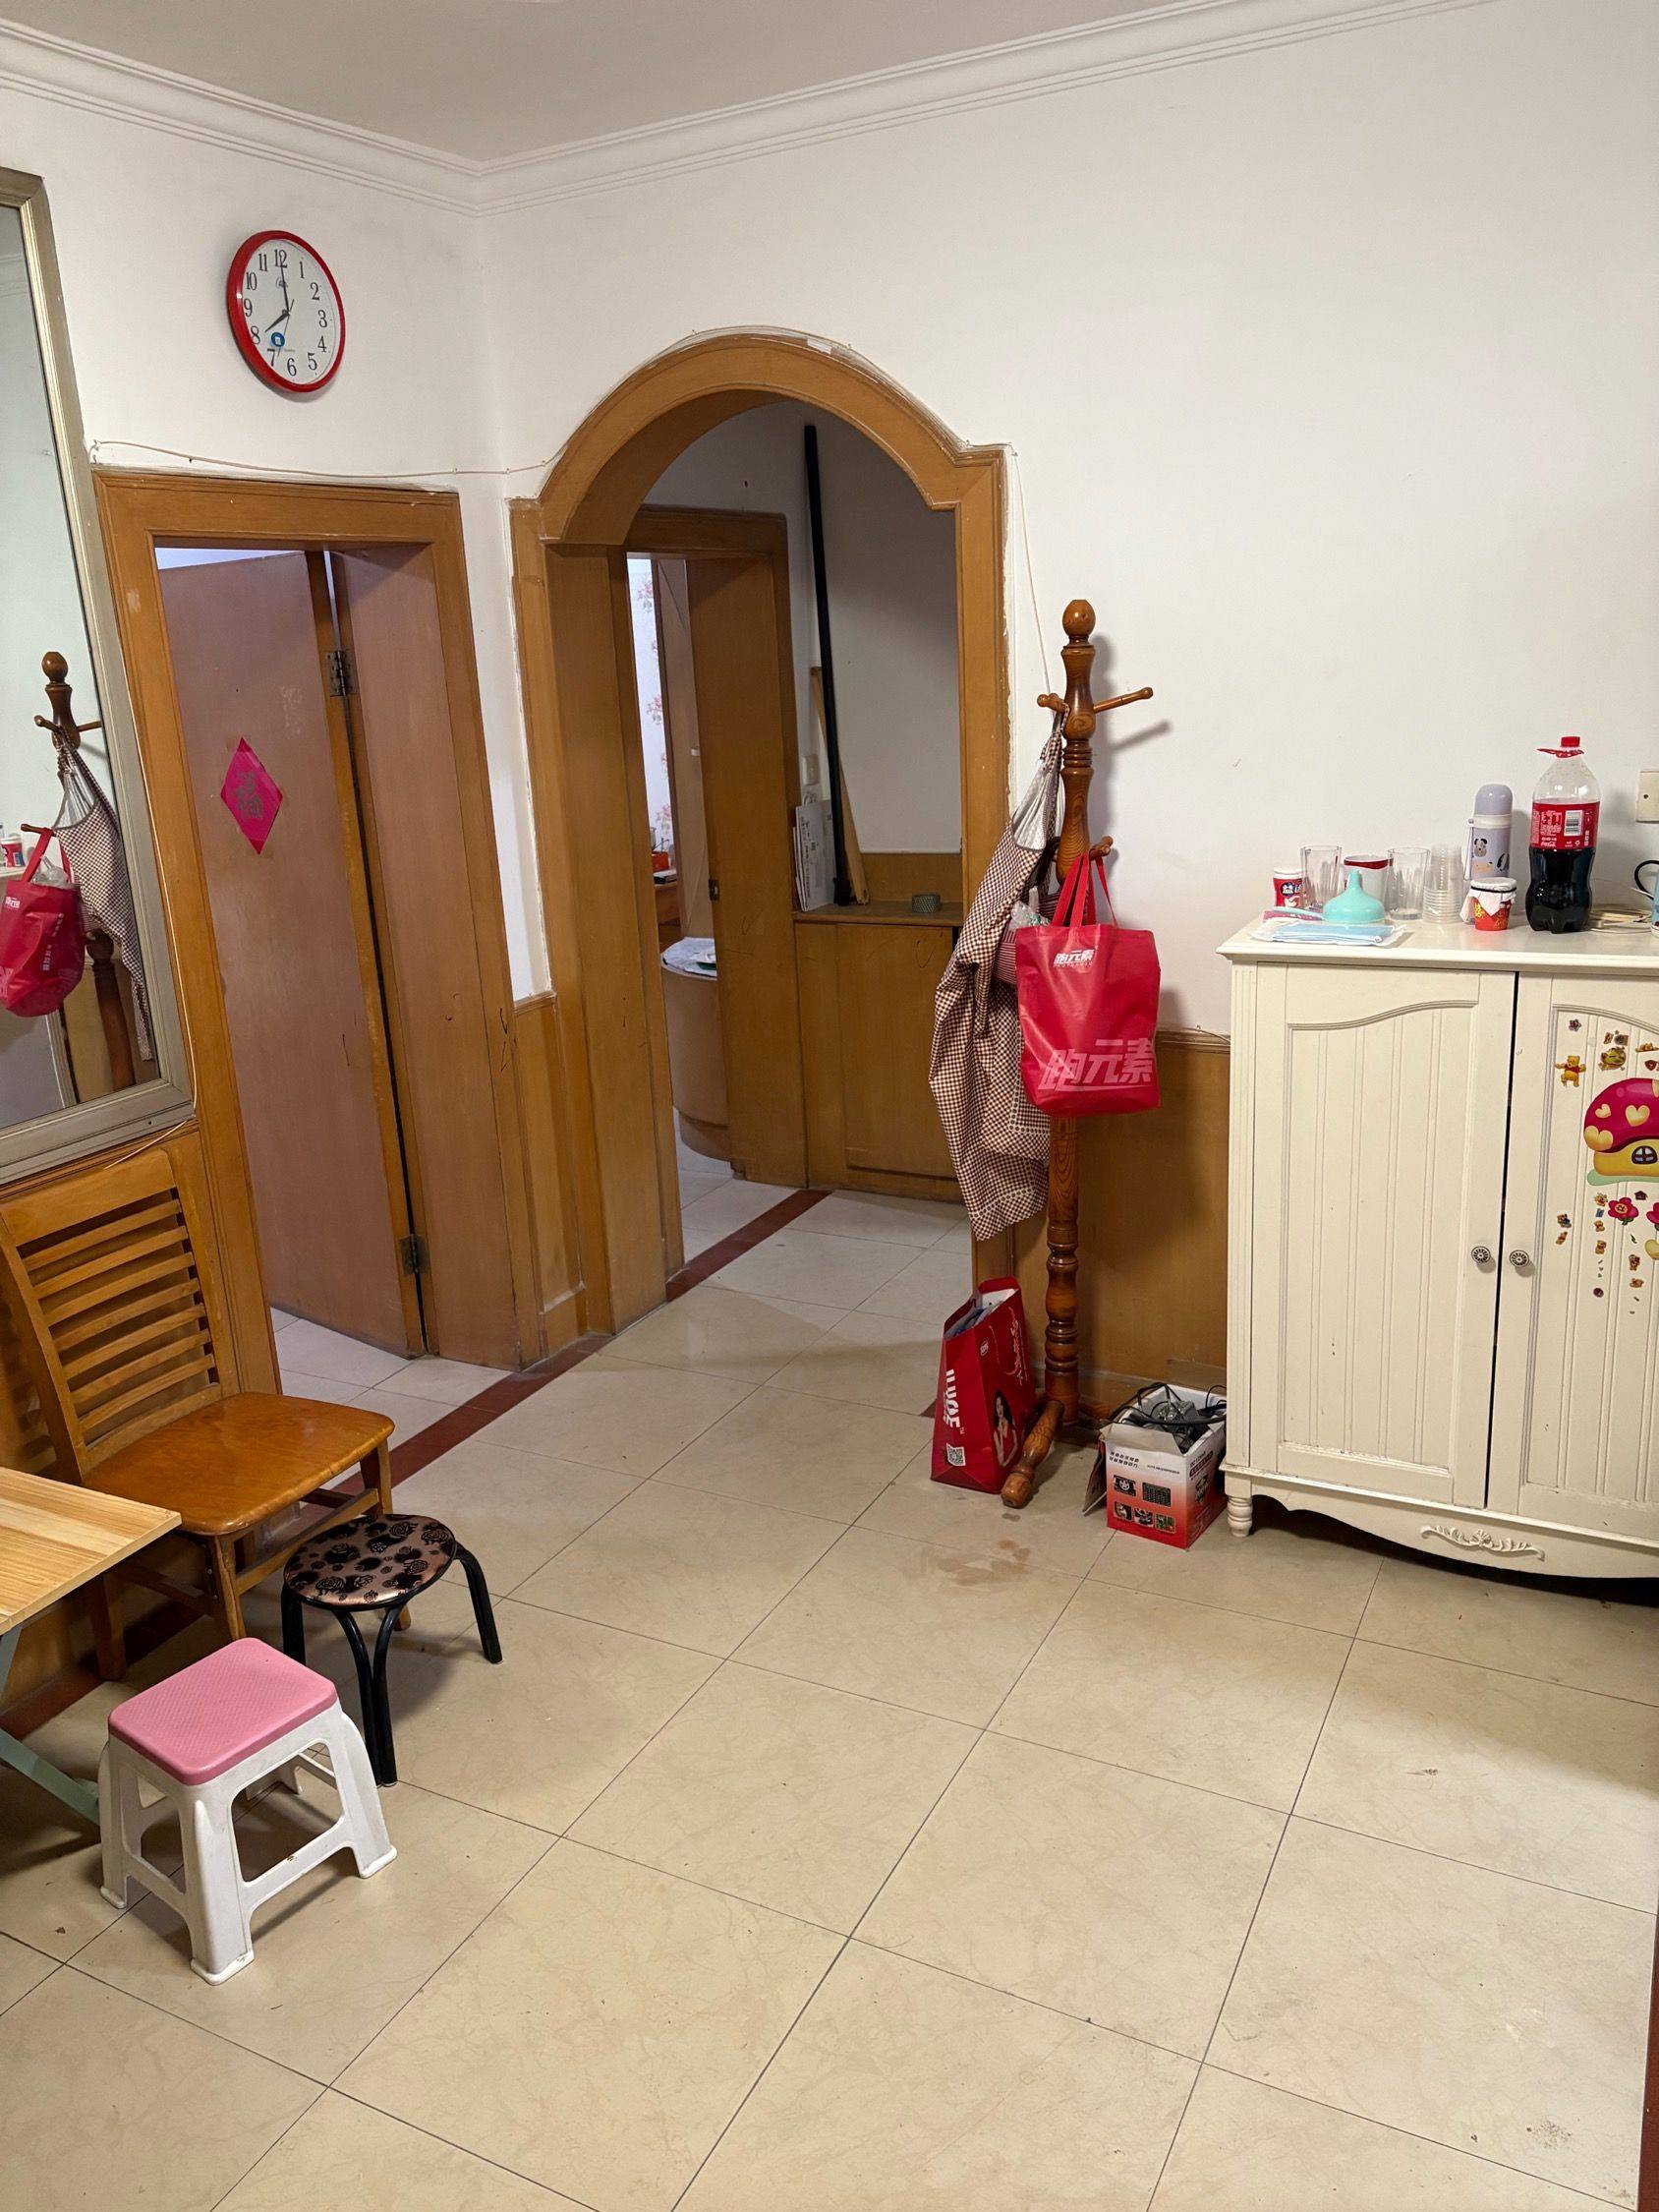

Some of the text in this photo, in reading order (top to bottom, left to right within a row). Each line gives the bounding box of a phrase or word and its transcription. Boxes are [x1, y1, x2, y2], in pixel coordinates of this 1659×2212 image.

[258, 253, 268, 271] 11
[274, 249, 288, 268] 12
[299, 261, 305, 279] 1
[246, 271, 257, 290] 10
[310, 282, 320, 301] 2
[243, 298, 253, 318] 9
[317, 309, 328, 328] 3
[250, 325, 261, 345] 8
[317, 335, 327, 353] 4
[266, 348, 276, 367] 7
[287, 357, 297, 377] 6
[307, 352, 317, 370] 5
[1037, 1037, 1154, 1092] 跑元素
